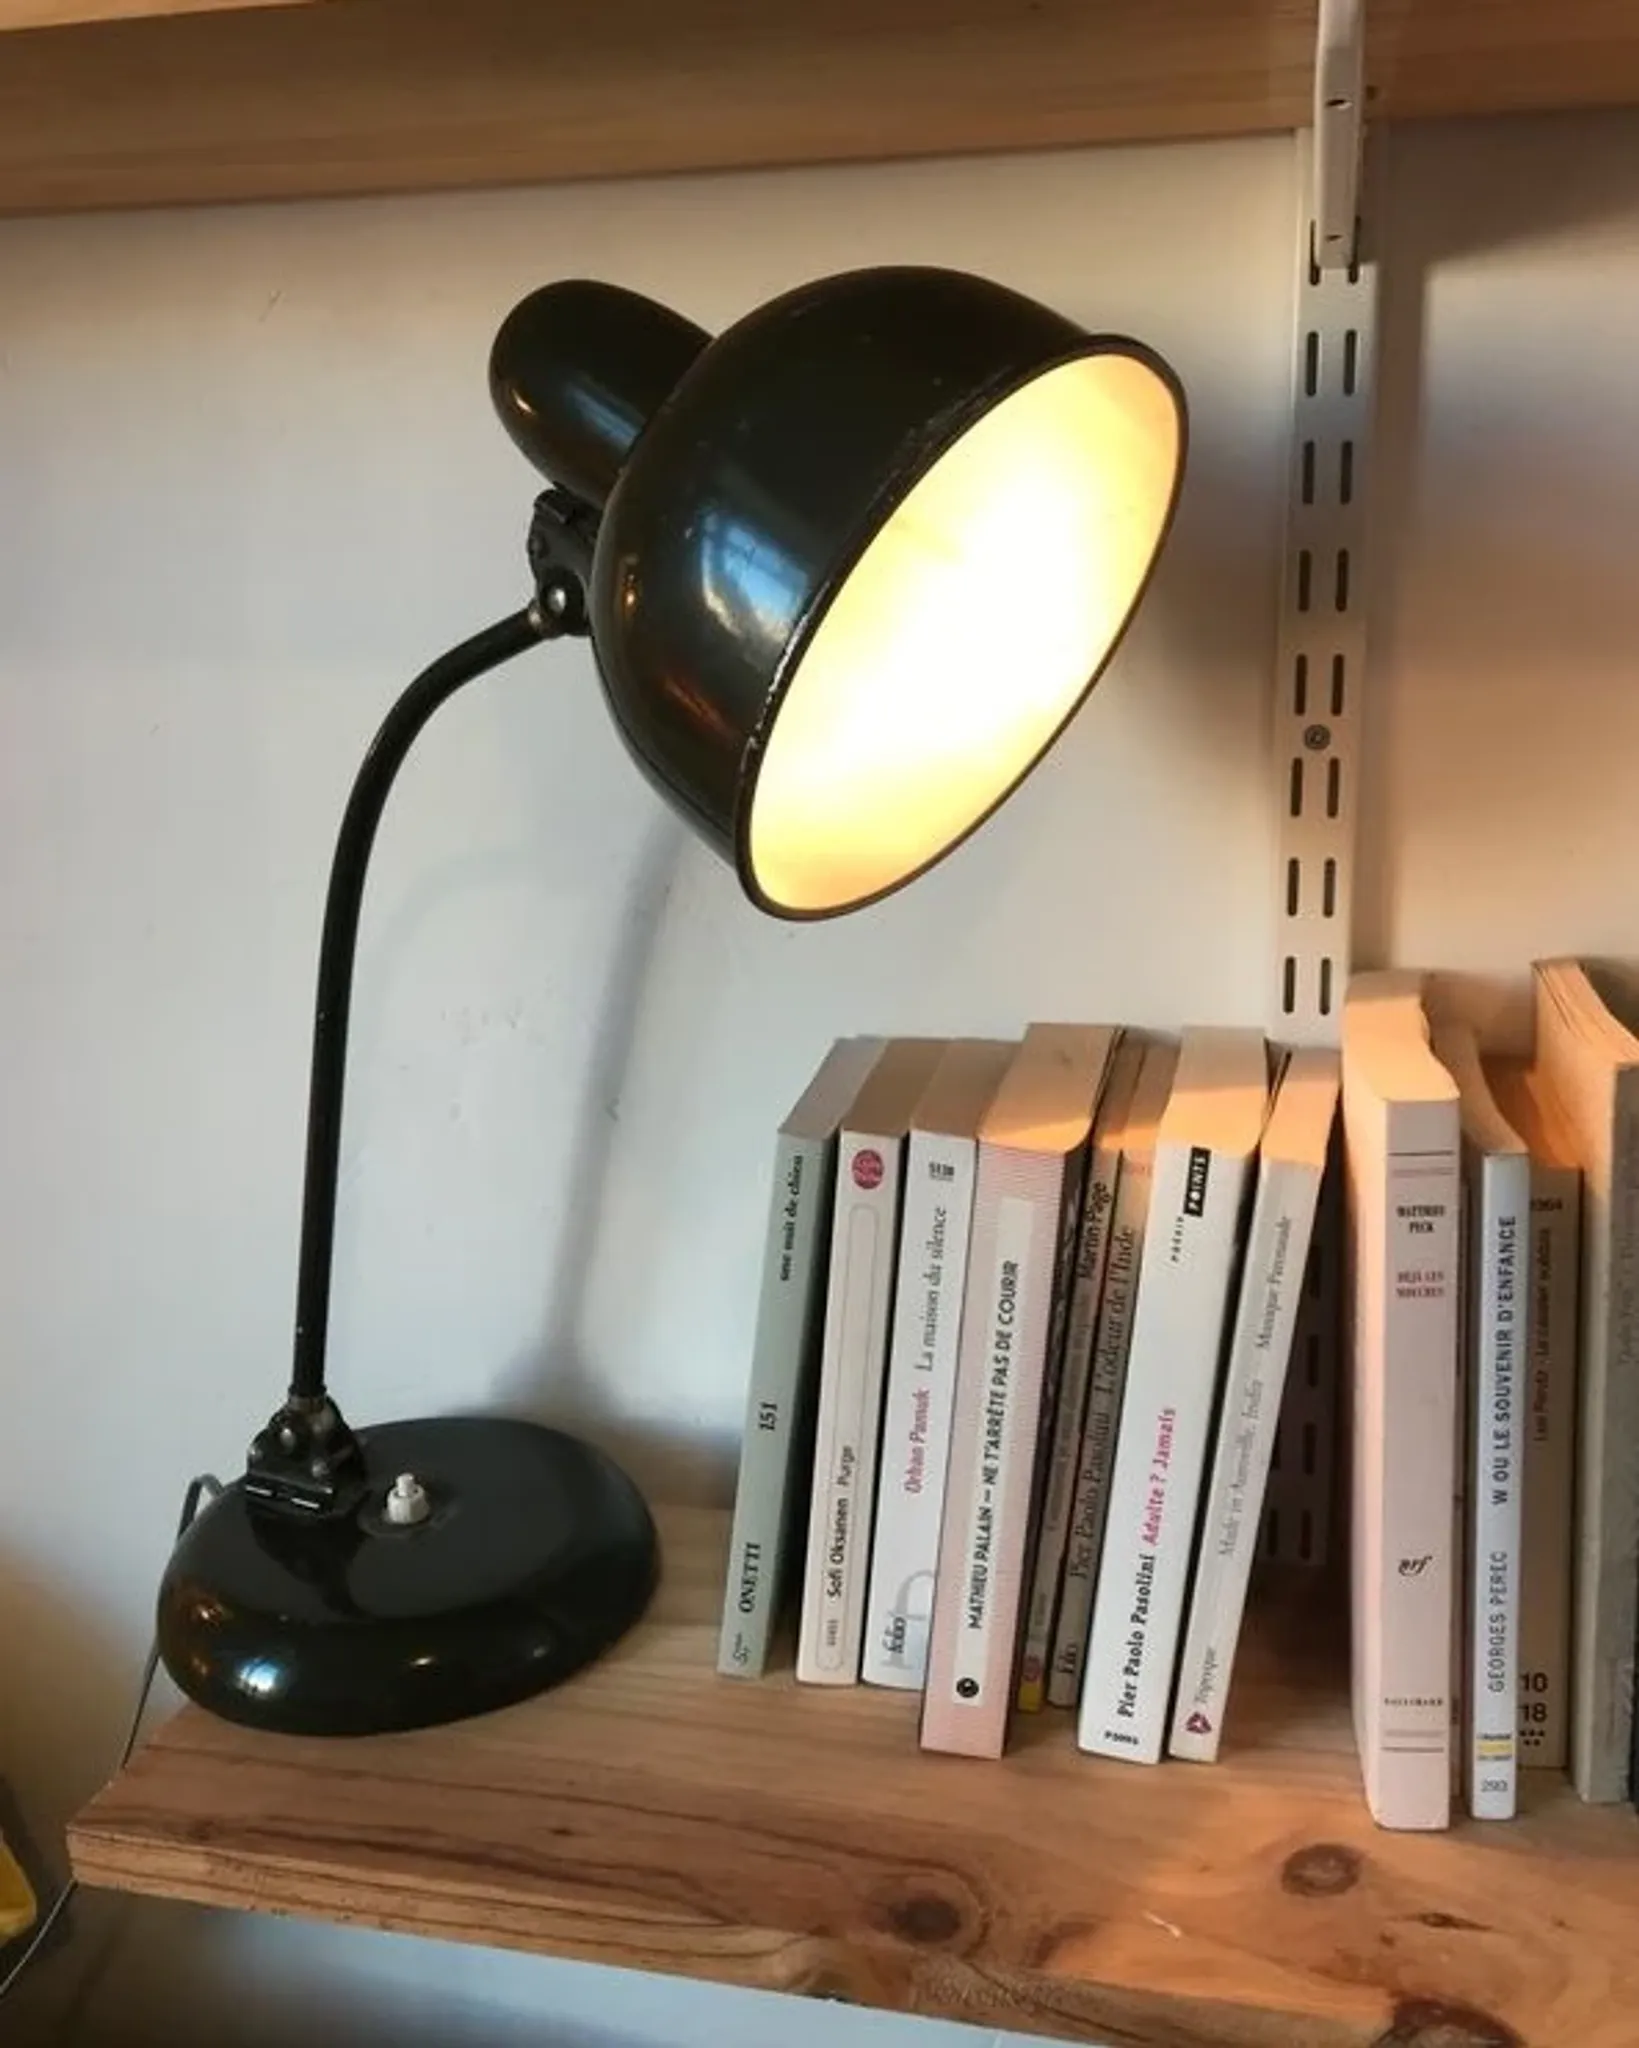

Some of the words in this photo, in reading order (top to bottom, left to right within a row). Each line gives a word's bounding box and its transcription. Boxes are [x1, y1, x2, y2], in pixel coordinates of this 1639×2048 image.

[1188, 1157, 1206, 1210] POINTS
[926, 1206, 948, 1261] silence
[1078, 1224, 1099, 1280] Martin
[1089, 1181, 1112, 1224] Page
[922, 1263, 943, 1287] du
[997, 1260, 1019, 1324] COURIR
[1498, 1216, 1516, 1322] D'ENFANCE
[918, 1290, 939, 1347] maison
[996, 1329, 1012, 1350] DE
[916, 1354, 934, 1372] La
[992, 1355, 1008, 1386] PAS
[1494, 1329, 1514, 1422] SOUVENIR
[760, 1401, 777, 1431] 151
[910, 1388, 931, 1444] Pamuk
[1152, 1407, 1175, 1470] Jamais
[1493, 1428, 1511, 1450] LE
[904, 1446, 925, 1494] Orhan
[984, 1469, 999, 1486] NE
[1493, 1456, 1510, 1483] OU
[1142, 1486, 1163, 1547] Adulte
[1492, 1489, 1508, 1505] W
[830, 1497, 849, 1564] Oksanen
[973, 1507, 992, 1564] PALAIN
[738, 1542, 761, 1614] ONETTI
[826, 1566, 843, 1598] Sofi
[968, 1566, 986, 1629] MATHIEU
[1131, 1553, 1156, 1625] Pasolini
[1490, 1552, 1508, 1605] PEREC
[1123, 1628, 1146, 1677] Paolo
[1487, 1615, 1507, 1693] GEORGES
[1118, 1678, 1141, 1718] Pier
[1519, 1672, 1549, 1693] 10
[1518, 1702, 1548, 1723] 18
